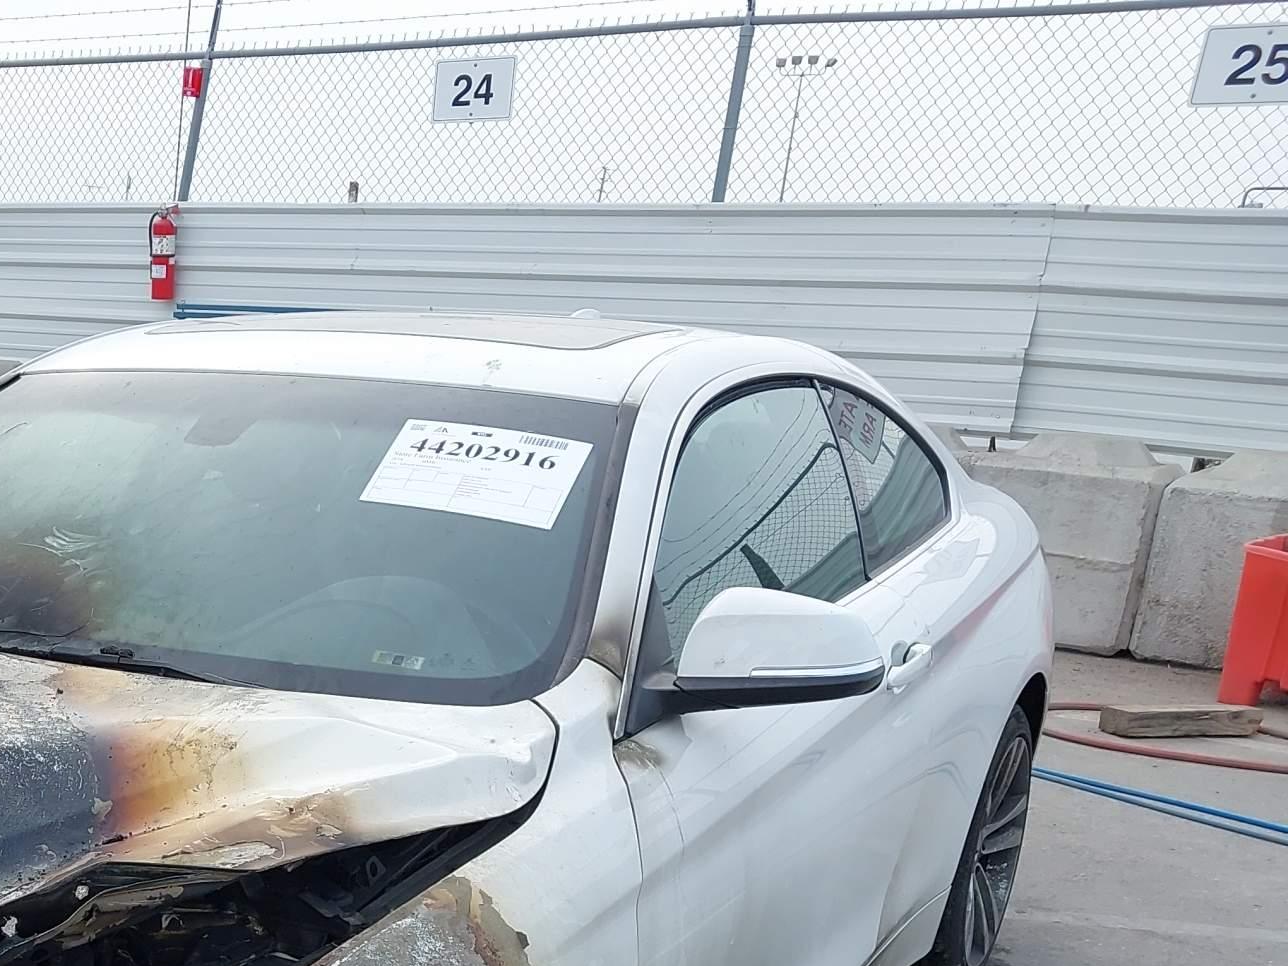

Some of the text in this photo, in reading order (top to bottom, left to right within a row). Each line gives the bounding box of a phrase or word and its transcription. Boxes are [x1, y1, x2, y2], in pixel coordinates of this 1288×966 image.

[1223, 43, 1288, 86] 25
[451, 73, 494, 107] 24
[410, 437, 560, 471] 44202916
